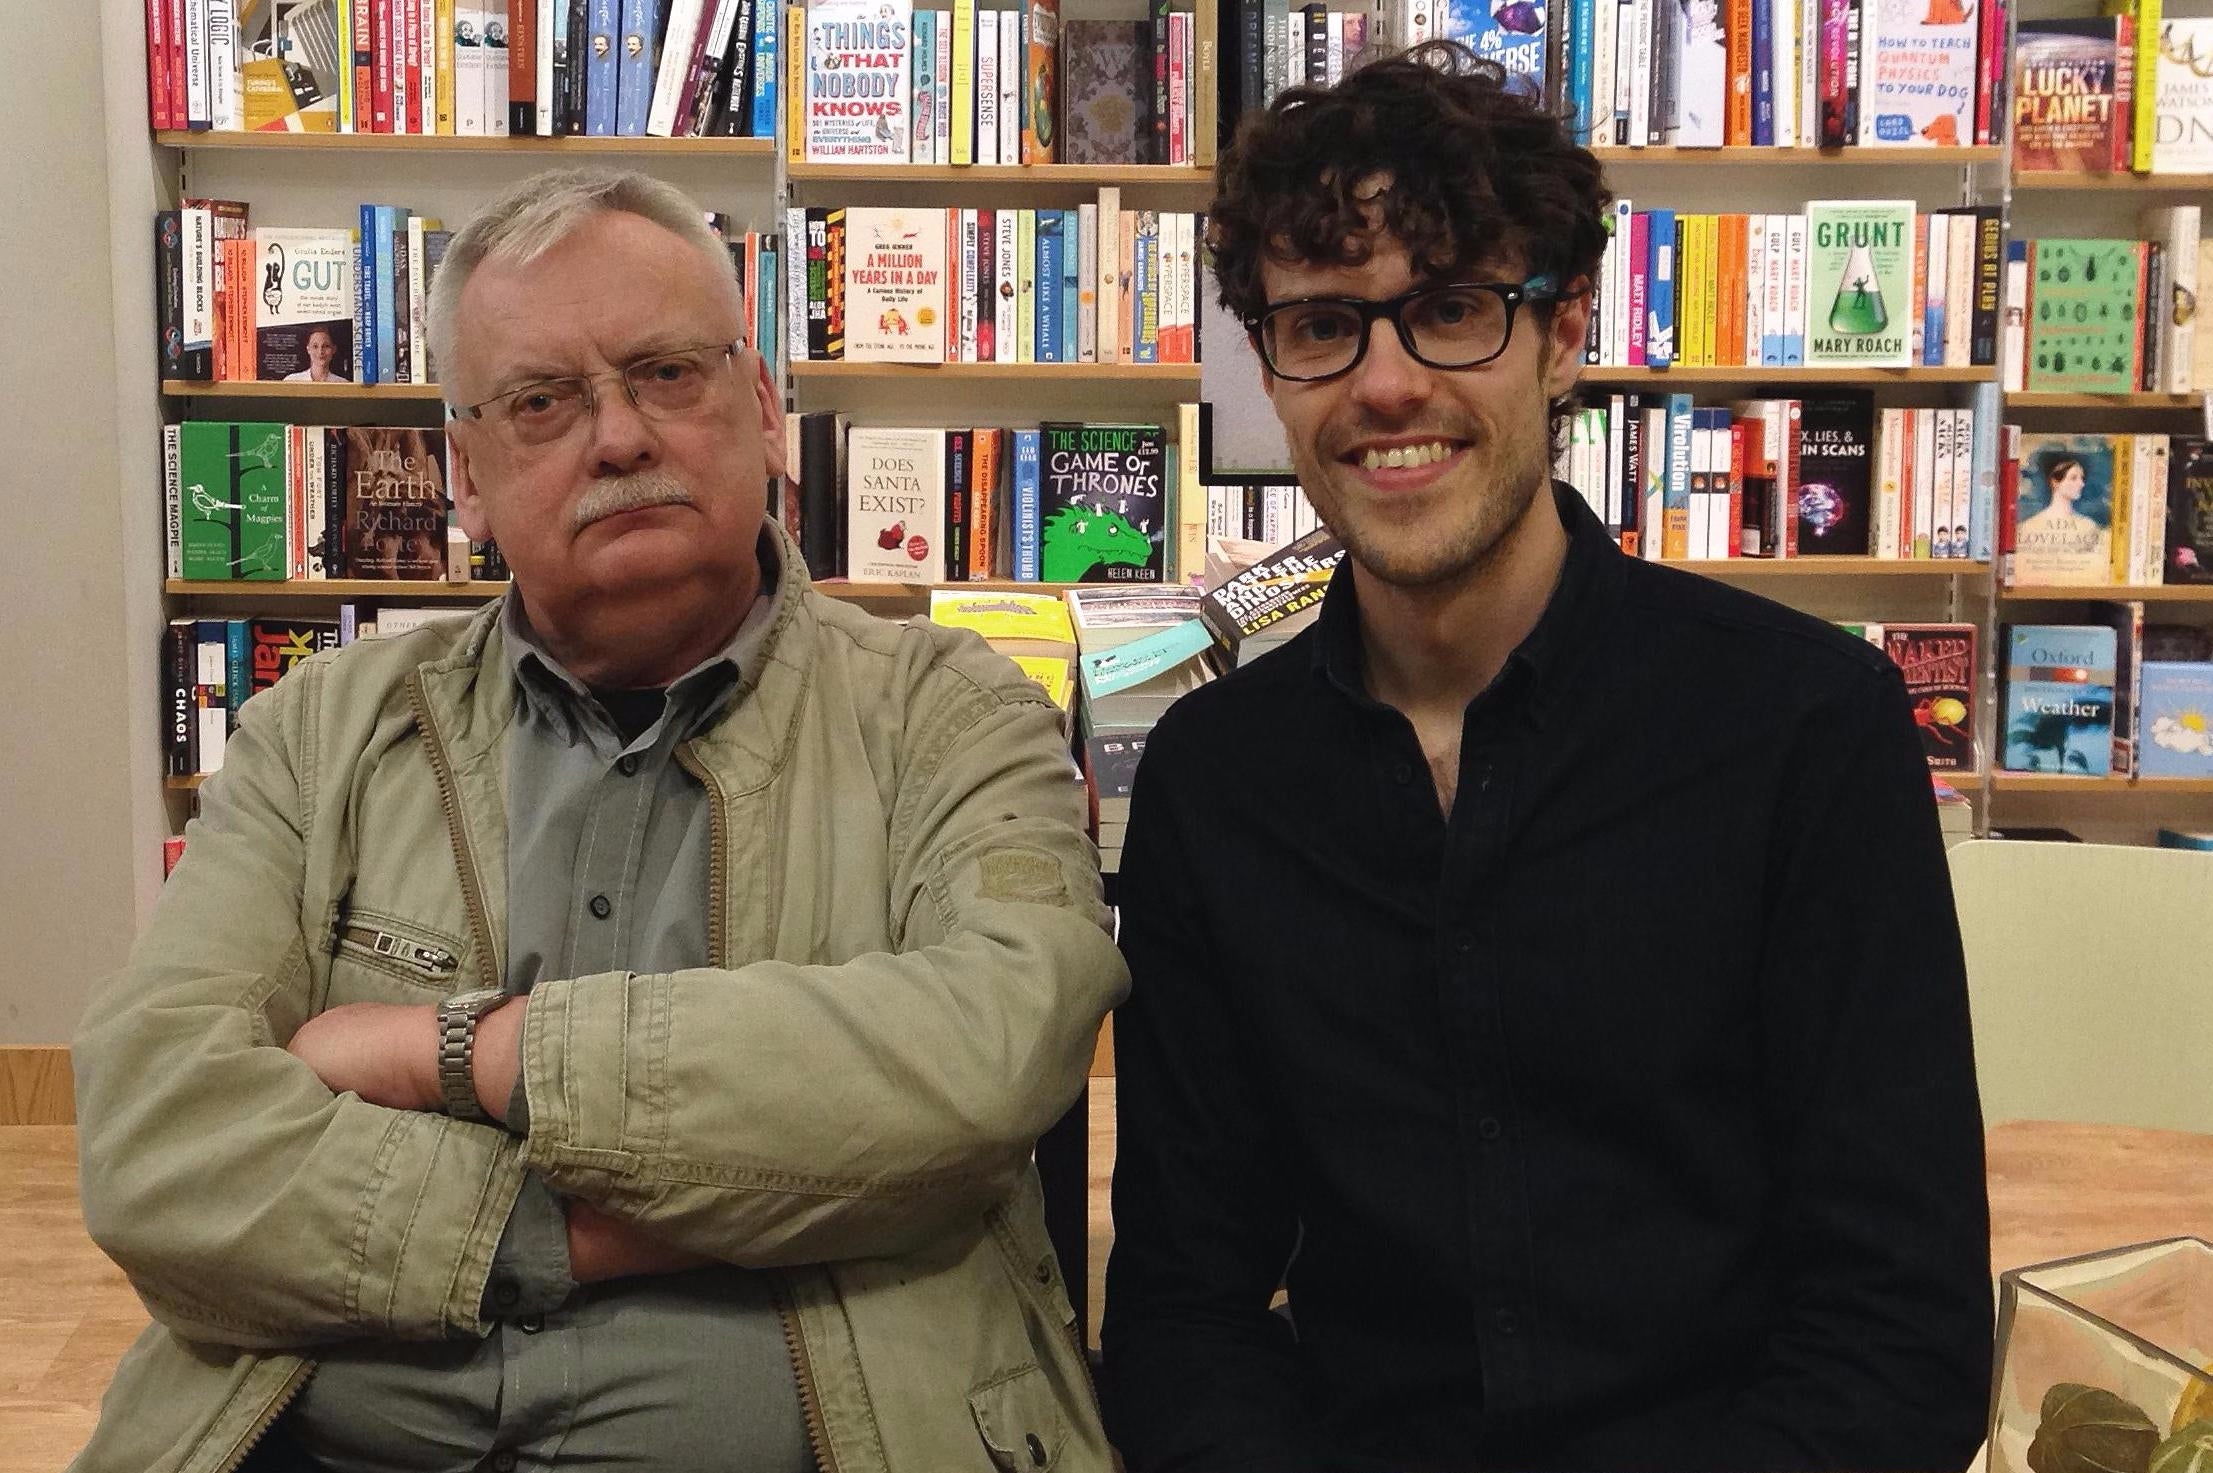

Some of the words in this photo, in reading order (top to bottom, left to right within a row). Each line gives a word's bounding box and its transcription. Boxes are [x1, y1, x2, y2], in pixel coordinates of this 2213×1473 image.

[210, 10, 230, 46] LOGIC
[822, 22, 906, 50] THINGS
[1267, 15, 1276, 63] FINDING
[1481, 29, 1503, 51] 4%
[517, 24, 525, 69] EINSTEIN
[1247, 11, 1258, 73] DREAMS
[1878, 36, 1907, 50] HOW
[1911, 39, 1928, 49] TO
[1931, 36, 1972, 50] TEACH
[190, 49, 200, 87] Universe
[840, 53, 904, 68] THAT
[1638, 48, 1648, 69] TABLE
[1877, 51, 1951, 65] QUANTUM
[813, 73, 899, 98] NOBODY
[1877, 66, 1940, 81] PHYSICS
[2021, 66, 2105, 96] LUCKY
[980, 57, 994, 127] SUPERSENSE
[1877, 83, 1894, 94] TO
[1896, 83, 1934, 96] YOUR
[1937, 84, 1969, 99] DOG
[2164, 82, 2210, 96] JAMES
[813, 102, 903, 117] KNOWS
[2015, 94, 2114, 124] PLANET
[812, 136, 872, 144] EVERYTHING
[812, 144, 846, 156] WILLIAM
[848, 144, 889, 156] HARTSTON
[195, 215, 203, 249] NATURE'S
[810, 230, 826, 247] TO
[966, 222, 976, 247] SIMPLY
[982, 231, 991, 255] STEVE
[1001, 218, 1012, 245] STEVE
[1770, 232, 1780, 253] GULP
[1792, 231, 1801, 254] GULP
[1817, 222, 1905, 249] GRUNT
[1983, 218, 2000, 260] GENIUS
[195, 251, 203, 283] BUILDING
[867, 254, 875, 267] A
[877, 253, 923, 268] MILLION
[1001, 247, 1012, 278] JONES
[1041, 238, 1051, 278] ALMOST
[1769, 259, 1779, 281] MARY
[1983, 263, 2000, 277] AT
[293, 259, 347, 291] GUT
[852, 270, 889, 285] YEARS
[890, 270, 904, 285] IN
[906, 271, 914, 285] A
[916, 271, 938, 285] DAY
[966, 249, 976, 293] COMPLEXITY
[982, 258, 991, 285] JONES
[195, 285, 203, 313] BLOCKS
[895, 288, 916, 296] History
[1041, 281, 1051, 303] LIKE
[1633, 274, 1644, 305] MATT
[1981, 282, 1997, 311] PLAY
[809, 309, 826, 320] JHA
[1633, 307, 1644, 347] RIDLEY
[353, 323, 363, 371] SCIENCE
[1814, 339, 1855, 353] MARY
[1856, 339, 1902, 353] ROACH
[167, 429, 177, 450] THE
[1050, 430, 1076, 451] THE
[1081, 430, 1137, 451] SCIENCE
[1627, 419, 1639, 452] JAMES
[1815, 431, 1841, 444] LIES,
[1844, 431, 1853, 443] &
[373, 450, 417, 471] The
[979, 454, 988, 470] THE
[1051, 452, 1119, 473] GAME
[1671, 414, 1691, 491] Virolution
[1822, 444, 1866, 457] SCANS
[168, 453, 178, 501] SCIENCE
[872, 458, 914, 472] DOES
[1627, 455, 1639, 484] WATT
[354, 470, 437, 500] Earth
[863, 475, 922, 492] SANTA
[1050, 473, 1159, 498] THRONES
[248, 493, 279, 503] Charm
[859, 495, 926, 514] EXIST?
[979, 472, 988, 535] DISAPPEARING
[169, 504, 179, 547] MAGPIE
[246, 513, 283, 524] Magpies
[356, 510, 437, 531] Richard
[1021, 486, 1034, 542] VIOLINIST'S
[979, 537, 988, 568] SPOON
[1021, 544, 1034, 579] THUMB
[887, 569, 922, 579] KAPLAN
[1107, 567, 1133, 579] HELEN
[1134, 568, 1156, 580] KEEN
[1210, 562, 1269, 602] DARK
[1216, 554, 1299, 608] MATTER
[1224, 582, 1268, 613] AND
[1276, 553, 1319, 584] THE
[1229, 547, 1348, 621] DINOSAURS
[1241, 607, 1284, 638] LISA
[2031, 648, 2095, 665] Oxford
[176, 687, 186, 743] CHAOS
[2021, 697, 2101, 717] Weather
